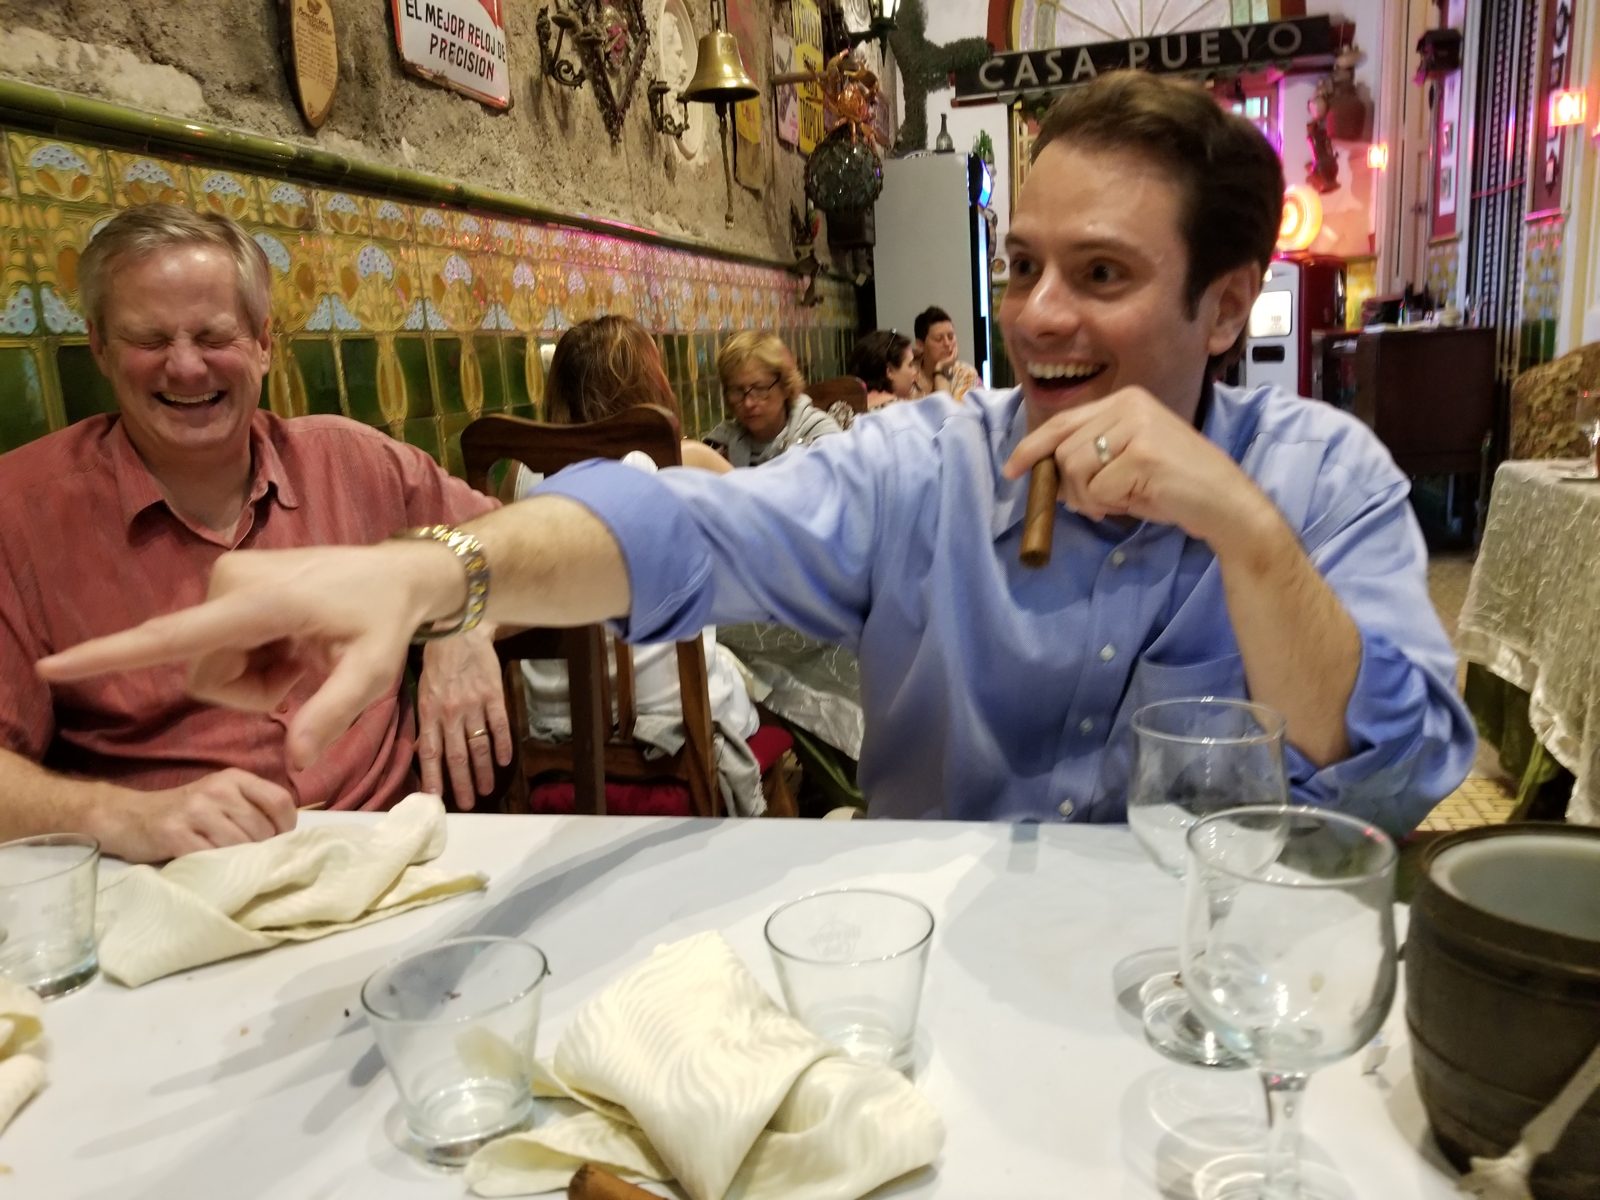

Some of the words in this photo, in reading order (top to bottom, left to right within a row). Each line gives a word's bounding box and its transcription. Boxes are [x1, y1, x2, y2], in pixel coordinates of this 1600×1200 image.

[405, 0, 422, 20] EL
[425, 3, 465, 39] MEJOR
[468, 22, 496, 56] RELOJ
[497, 40, 506, 63] DE
[429, 33, 495, 81] PRECISION
[978, 47, 1098, 89] CASA
[1128, 23, 1302, 70] PUEYO
